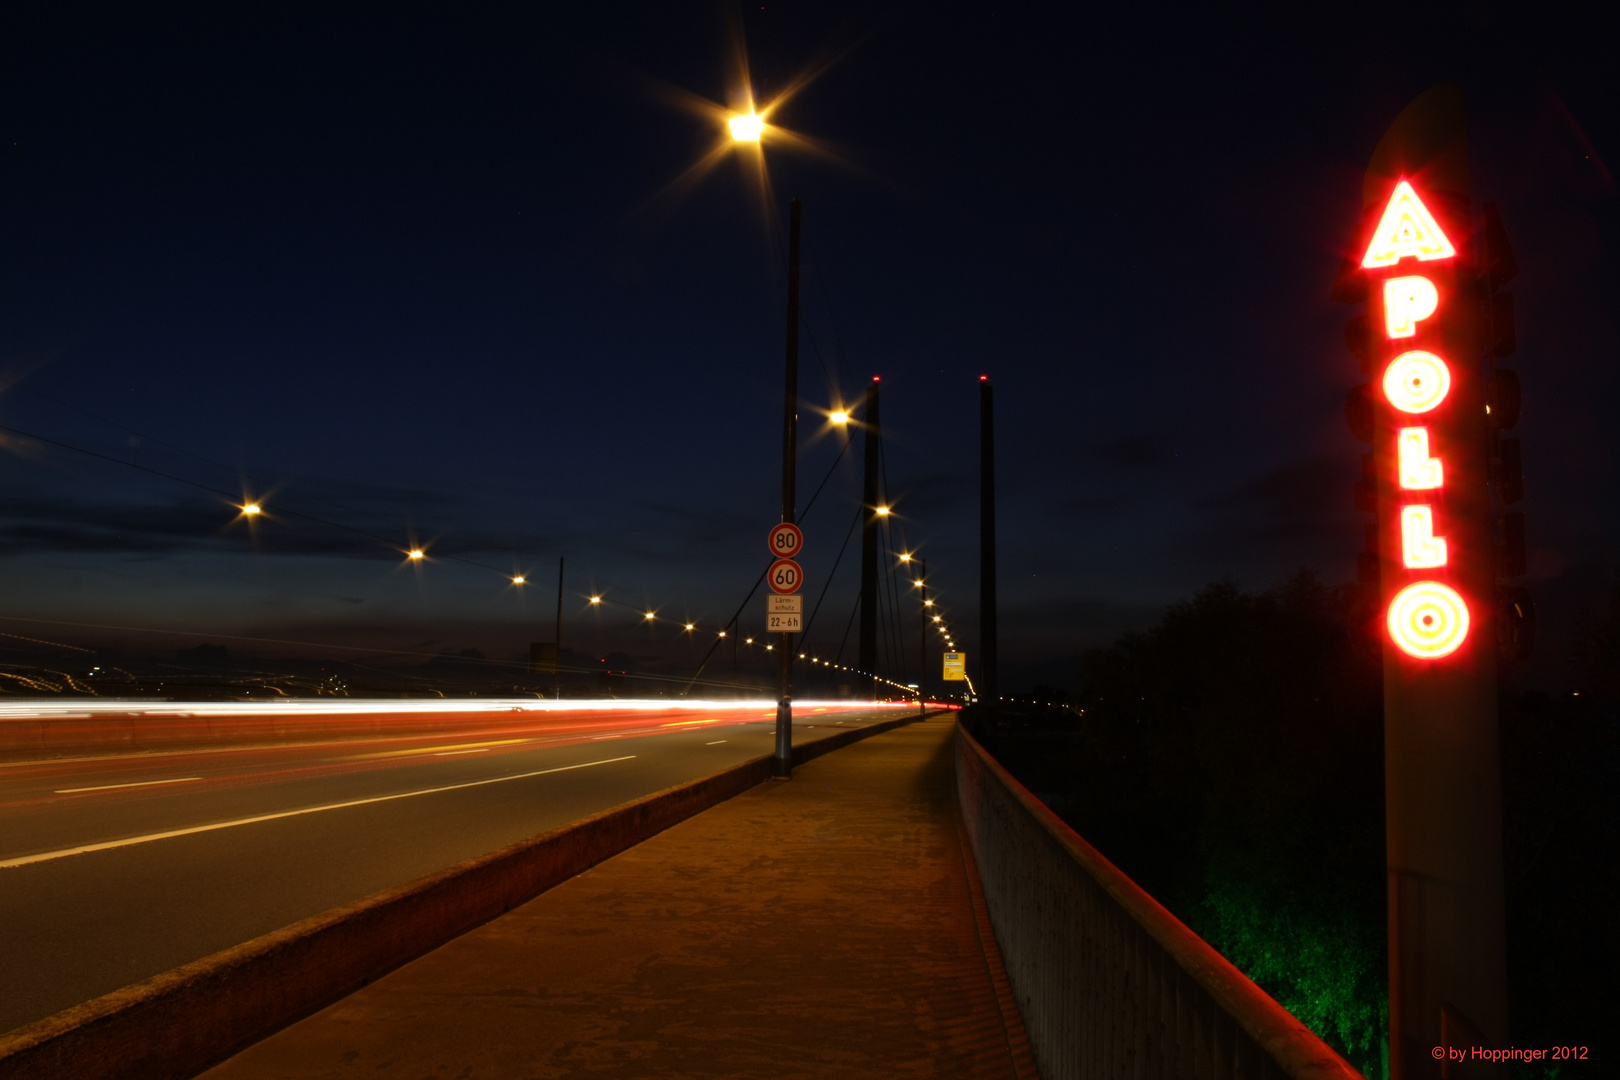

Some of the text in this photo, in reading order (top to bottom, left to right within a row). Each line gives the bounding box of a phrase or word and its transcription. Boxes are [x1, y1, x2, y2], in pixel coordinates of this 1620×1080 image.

[1360, 178, 1470, 659] APOLLO
[776, 533, 795, 549] 80
[775, 569, 795, 585] 60
